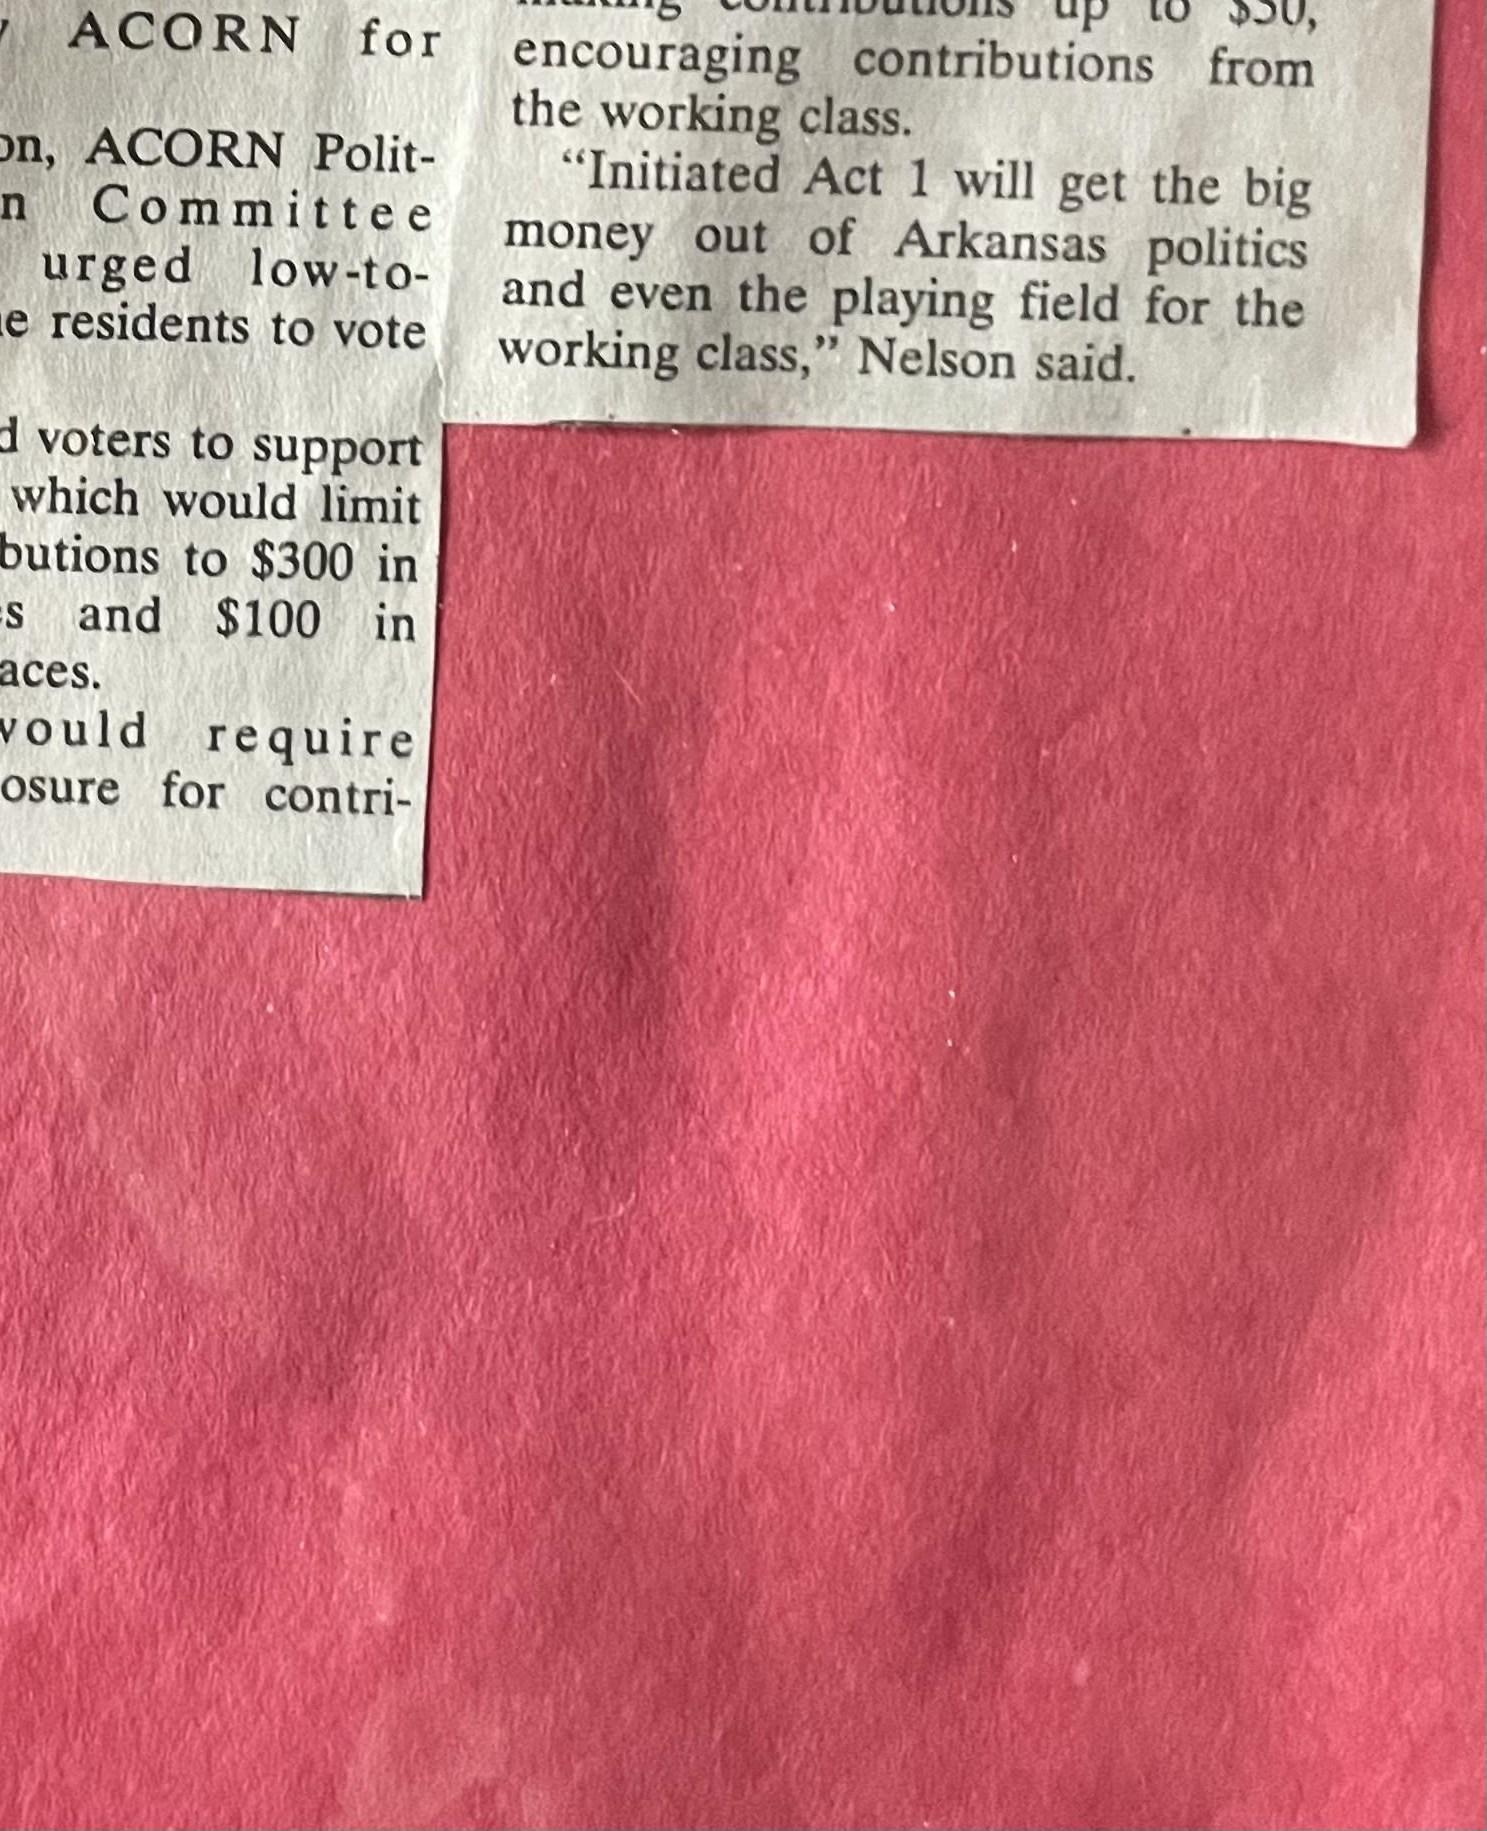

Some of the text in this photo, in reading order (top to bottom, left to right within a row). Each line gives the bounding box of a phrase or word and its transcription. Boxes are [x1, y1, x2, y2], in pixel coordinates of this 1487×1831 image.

[513, 31, 1314, 89] encouraging contributions from
[512, 86, 912, 147] the working class.
[84, 126, 285, 170] ACORN
[314, 131, 436, 175] Polit-
[51, 300, 250, 345] residents
[271, 311, 315, 348] to
[333, 314, 426, 351] vote
[502, 268, 1305, 332] and even the playing field for the
[37, 422, 171, 460] voters
[191, 425, 234, 462] to
[253, 433, 423, 478] support
[162, 769, 226, 812] for
[265, 776, 411, 817] contri-
